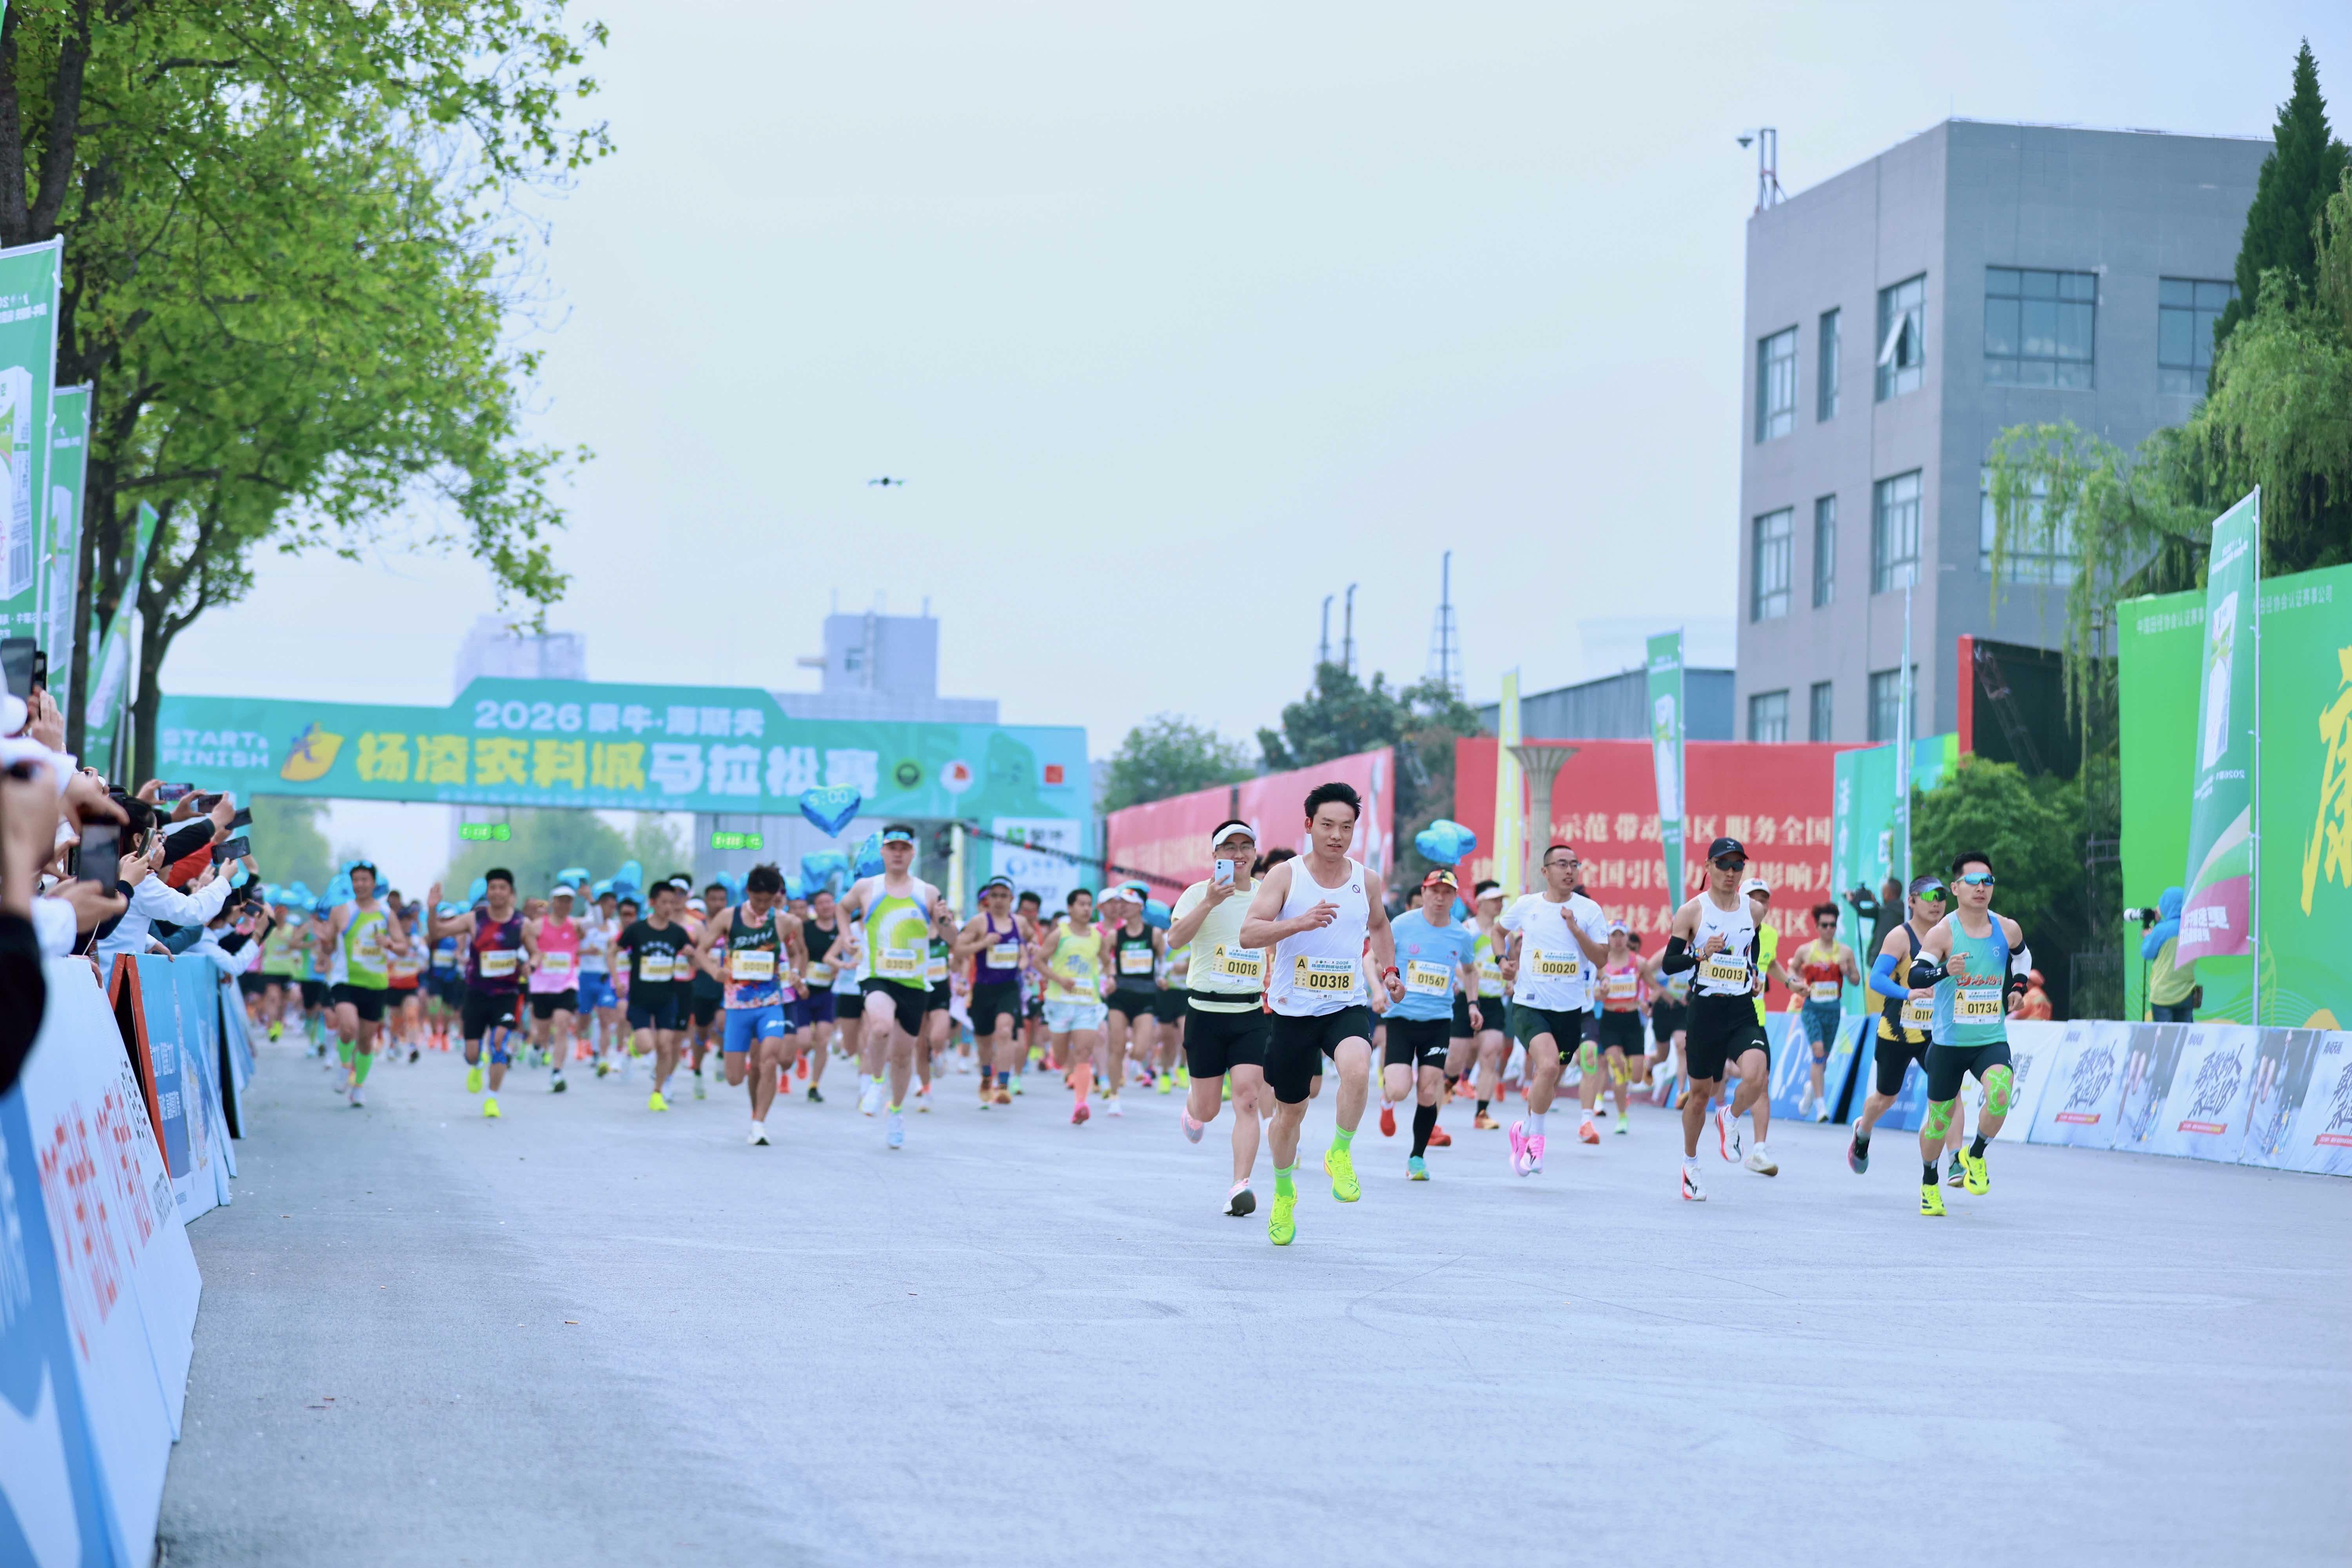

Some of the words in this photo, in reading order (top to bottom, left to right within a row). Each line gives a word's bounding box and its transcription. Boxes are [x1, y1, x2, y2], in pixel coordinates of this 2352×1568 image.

[474, 699, 583, 732] 2026
[162, 748, 270, 768] FINISH
[1726, 815, 1832, 846] 服务全国
[1216, 947, 1223, 956] A
[1228, 961, 1257, 976] 01018
[1297, 958, 1306, 969] A
[1543, 963, 1576, 973] 00020
[1418, 973, 1445, 987] 01567
[1711, 967, 1742, 980] 00013
[1310, 974, 1349, 988] 00318
[1956, 992, 1964, 1000] A
[1967, 1002, 1998, 1014] 01734
